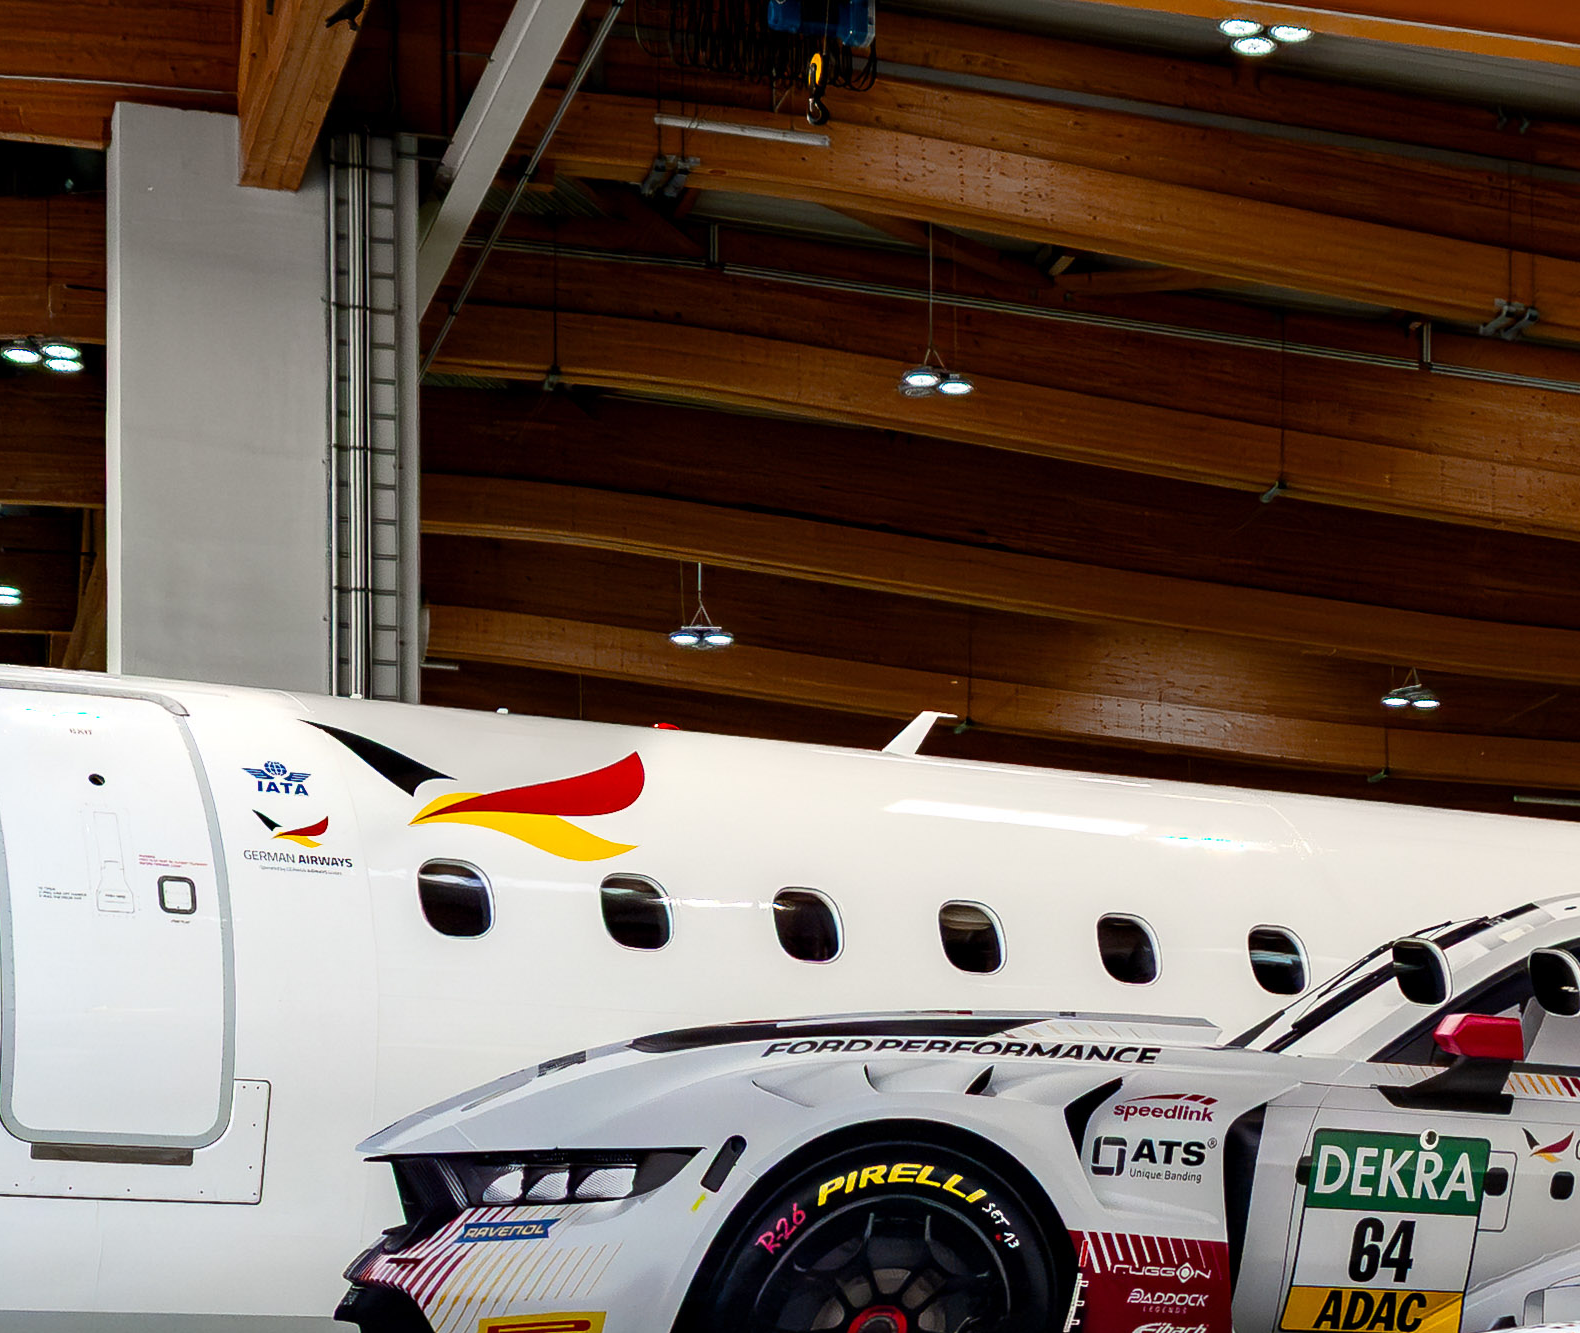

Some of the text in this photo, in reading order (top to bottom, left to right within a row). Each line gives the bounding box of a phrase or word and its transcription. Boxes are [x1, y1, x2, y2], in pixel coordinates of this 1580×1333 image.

[257, 780, 309, 796] IATA
[243, 849, 353, 868] GERMAN AIRWAYS
[762, 1039, 1160, 1064] FORD PERFORMANCE
[1113, 1104, 1214, 1122] speedlink
[1131, 1138, 1206, 1166] ATS
[817, 1162, 987, 1206] PIRELLI
[1130, 1168, 1202, 1184] Unique Banding
[1314, 1144, 1477, 1203] DEKRA
[464, 1224, 544, 1238] RAVENOL
[1348, 1217, 1415, 1283] 64
[1314, 1290, 1428, 1332] ADAC
